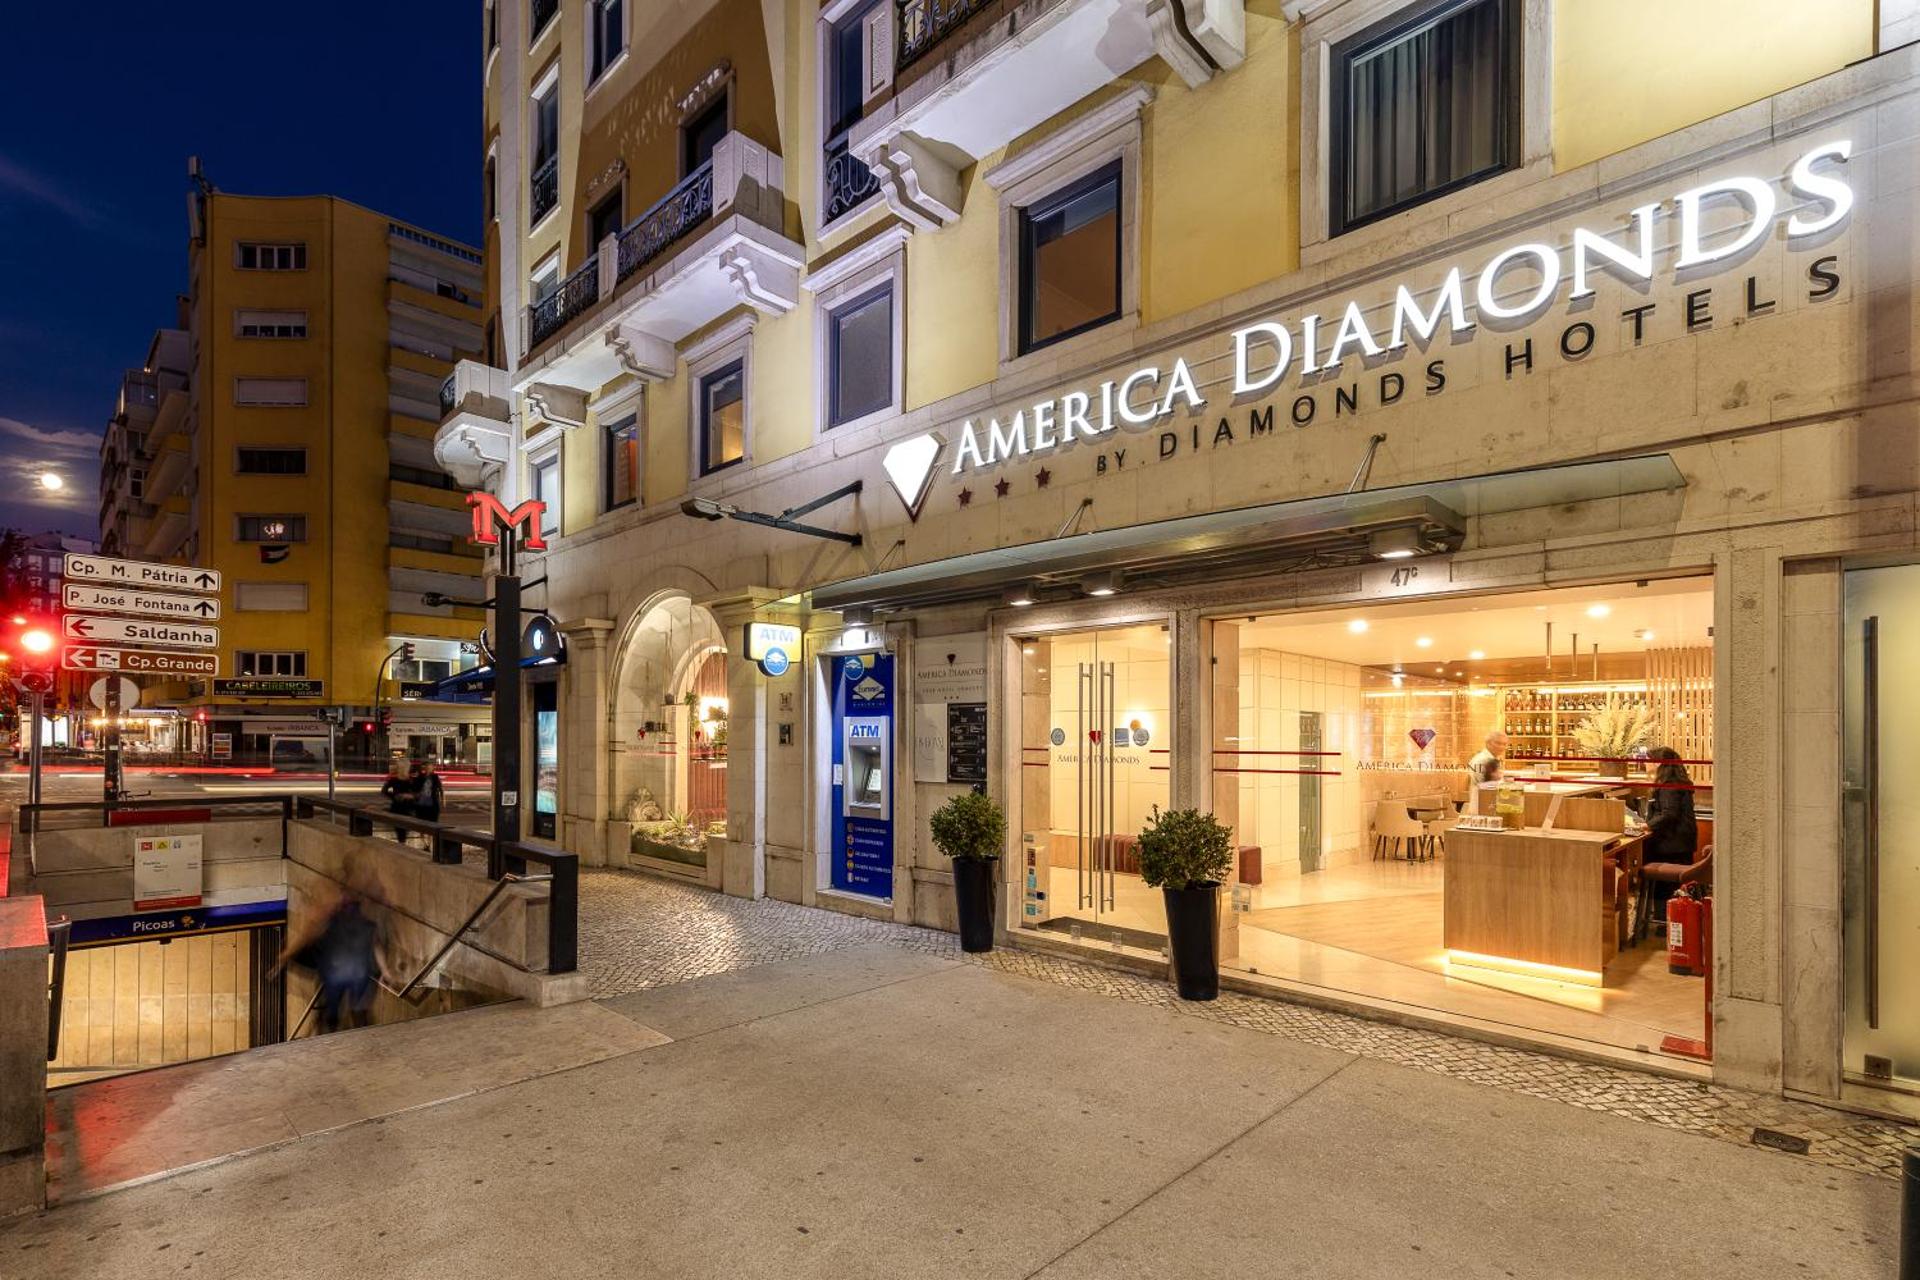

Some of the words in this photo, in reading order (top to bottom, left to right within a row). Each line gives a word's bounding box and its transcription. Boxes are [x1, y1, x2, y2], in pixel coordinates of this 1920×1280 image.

[952, 356, 1206, 475] AMERICA
[1230, 139, 1856, 395] DIAMONDS
[1096, 449, 1127, 473] BY
[1159, 360, 1447, 459] DIAMONDS
[1504, 255, 1841, 375] HOTELS
[71, 560, 100, 575] Cp.
[111, 564, 131, 578] M.
[142, 568, 188, 584] Pátria
[70, 591, 84, 602] P.
[93, 593, 126, 606] José
[135, 597, 190, 612] Fontana
[124, 625, 213, 643] Saldanha
[759, 627, 794, 642] ATM
[127, 655, 214, 671] Cp.Grande
[851, 724, 879, 737] ATM
[133, 919, 175, 932] Picoas
